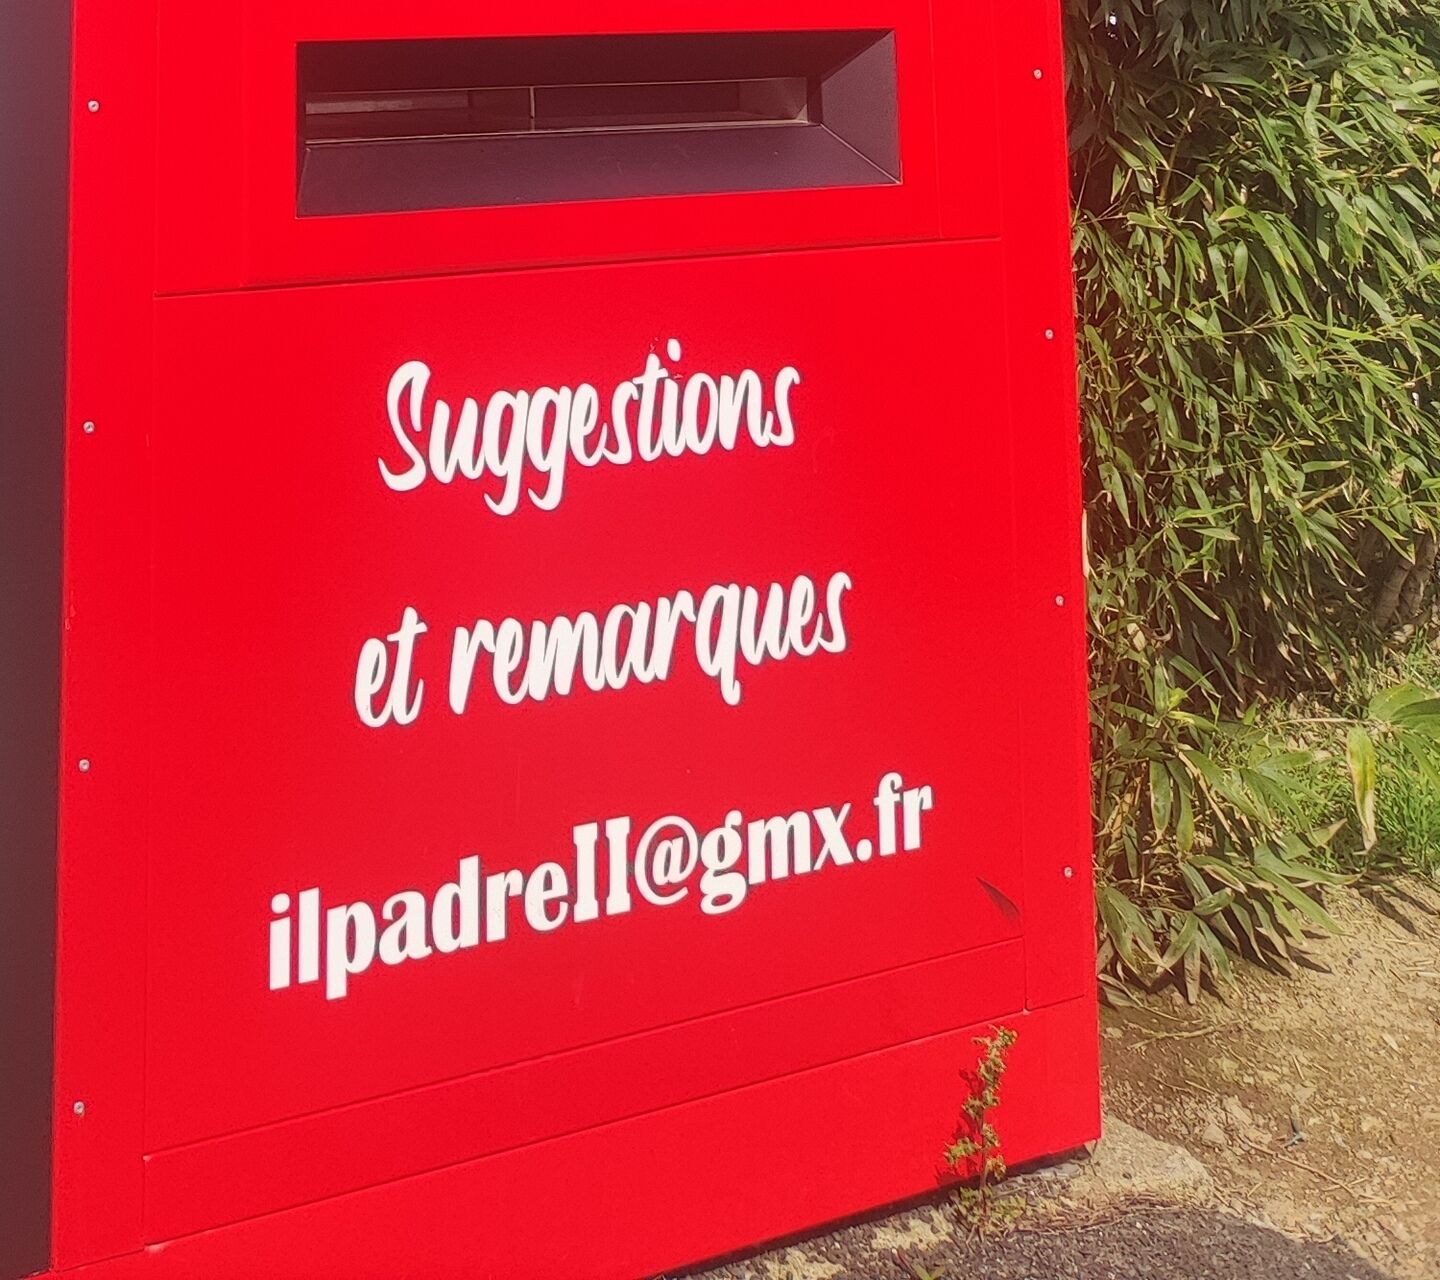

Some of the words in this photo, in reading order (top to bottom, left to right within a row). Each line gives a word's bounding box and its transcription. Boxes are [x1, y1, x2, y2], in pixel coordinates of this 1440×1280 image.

[379, 338, 800, 516] Suggestions
[354, 606, 427, 728] et
[448, 571, 852, 715] remarques
